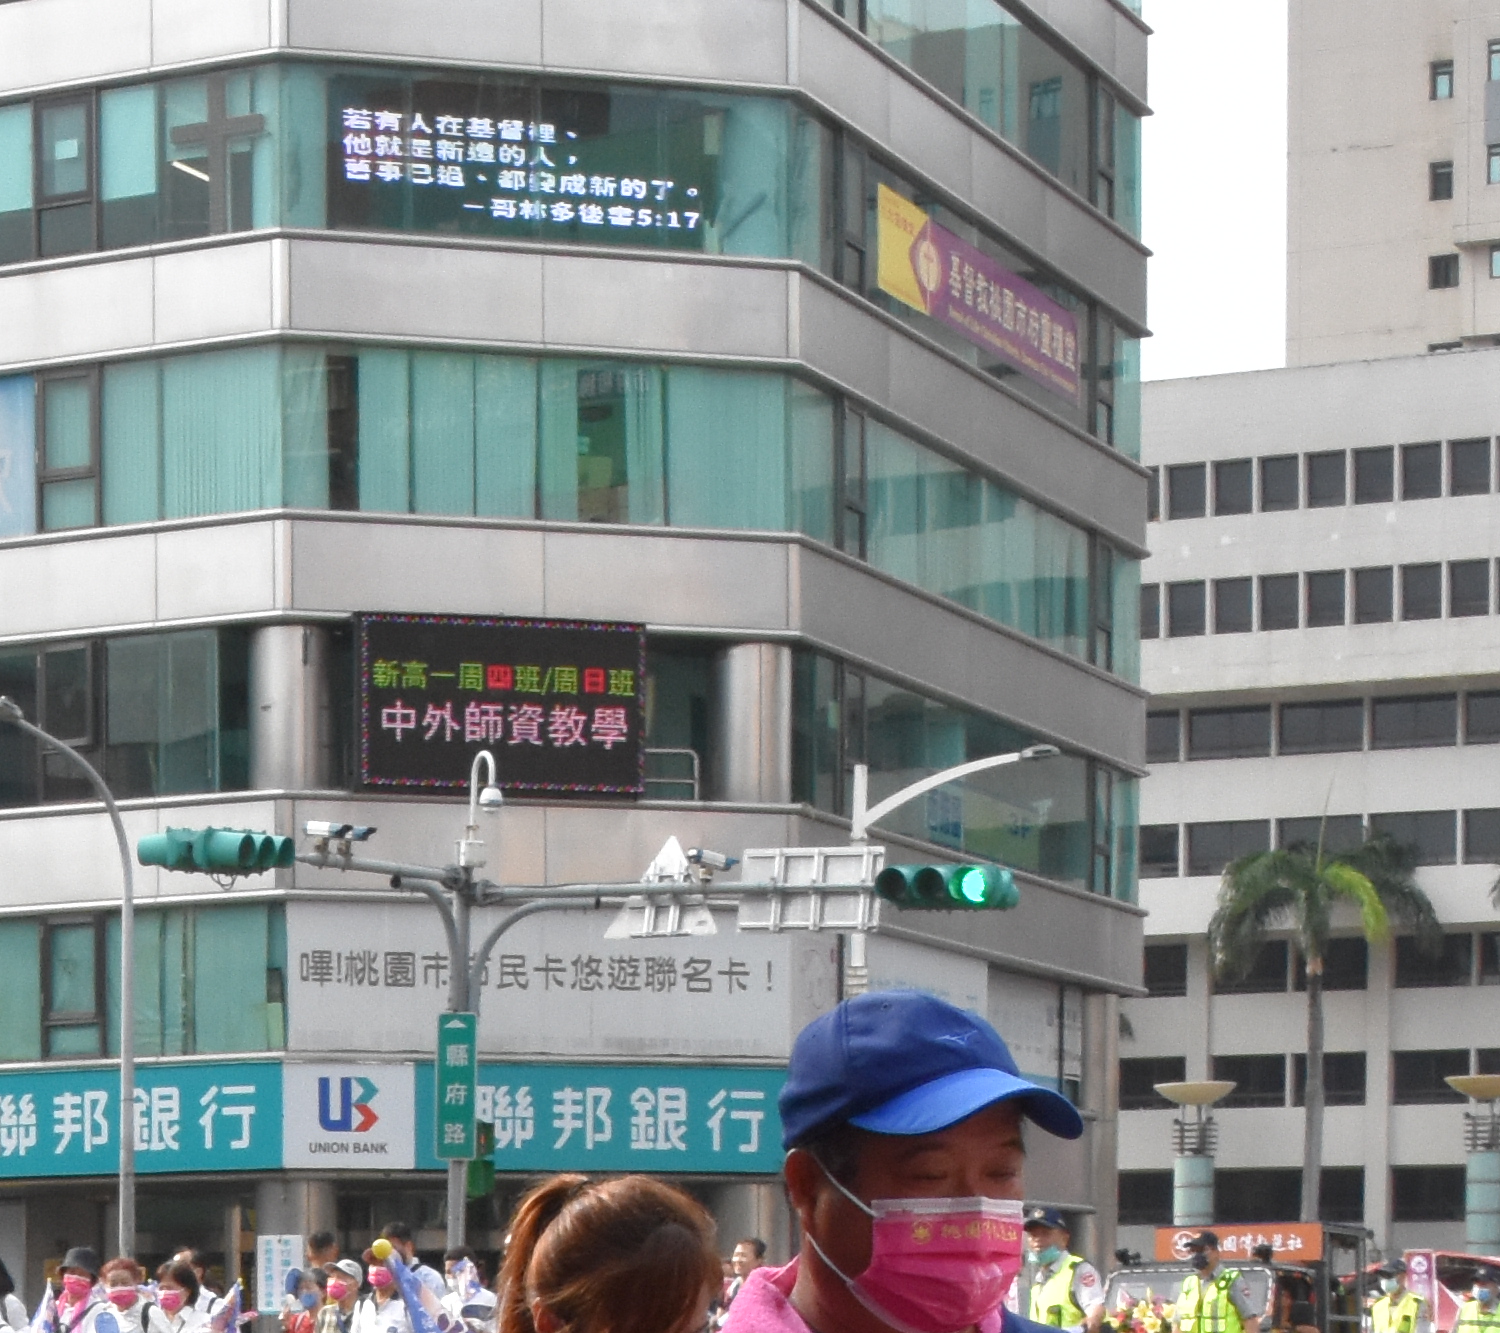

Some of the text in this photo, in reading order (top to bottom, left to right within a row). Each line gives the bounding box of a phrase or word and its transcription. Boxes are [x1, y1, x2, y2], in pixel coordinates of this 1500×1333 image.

[373, 658, 636, 699] 新高一周四班/周日班
[381, 701, 631, 750] 中外師資教學
[444, 1043, 472, 1147] 縣府路
[474, 1087, 765, 1155] 聯邦銀行
[308, 1141, 389, 1155] UNION BANK
